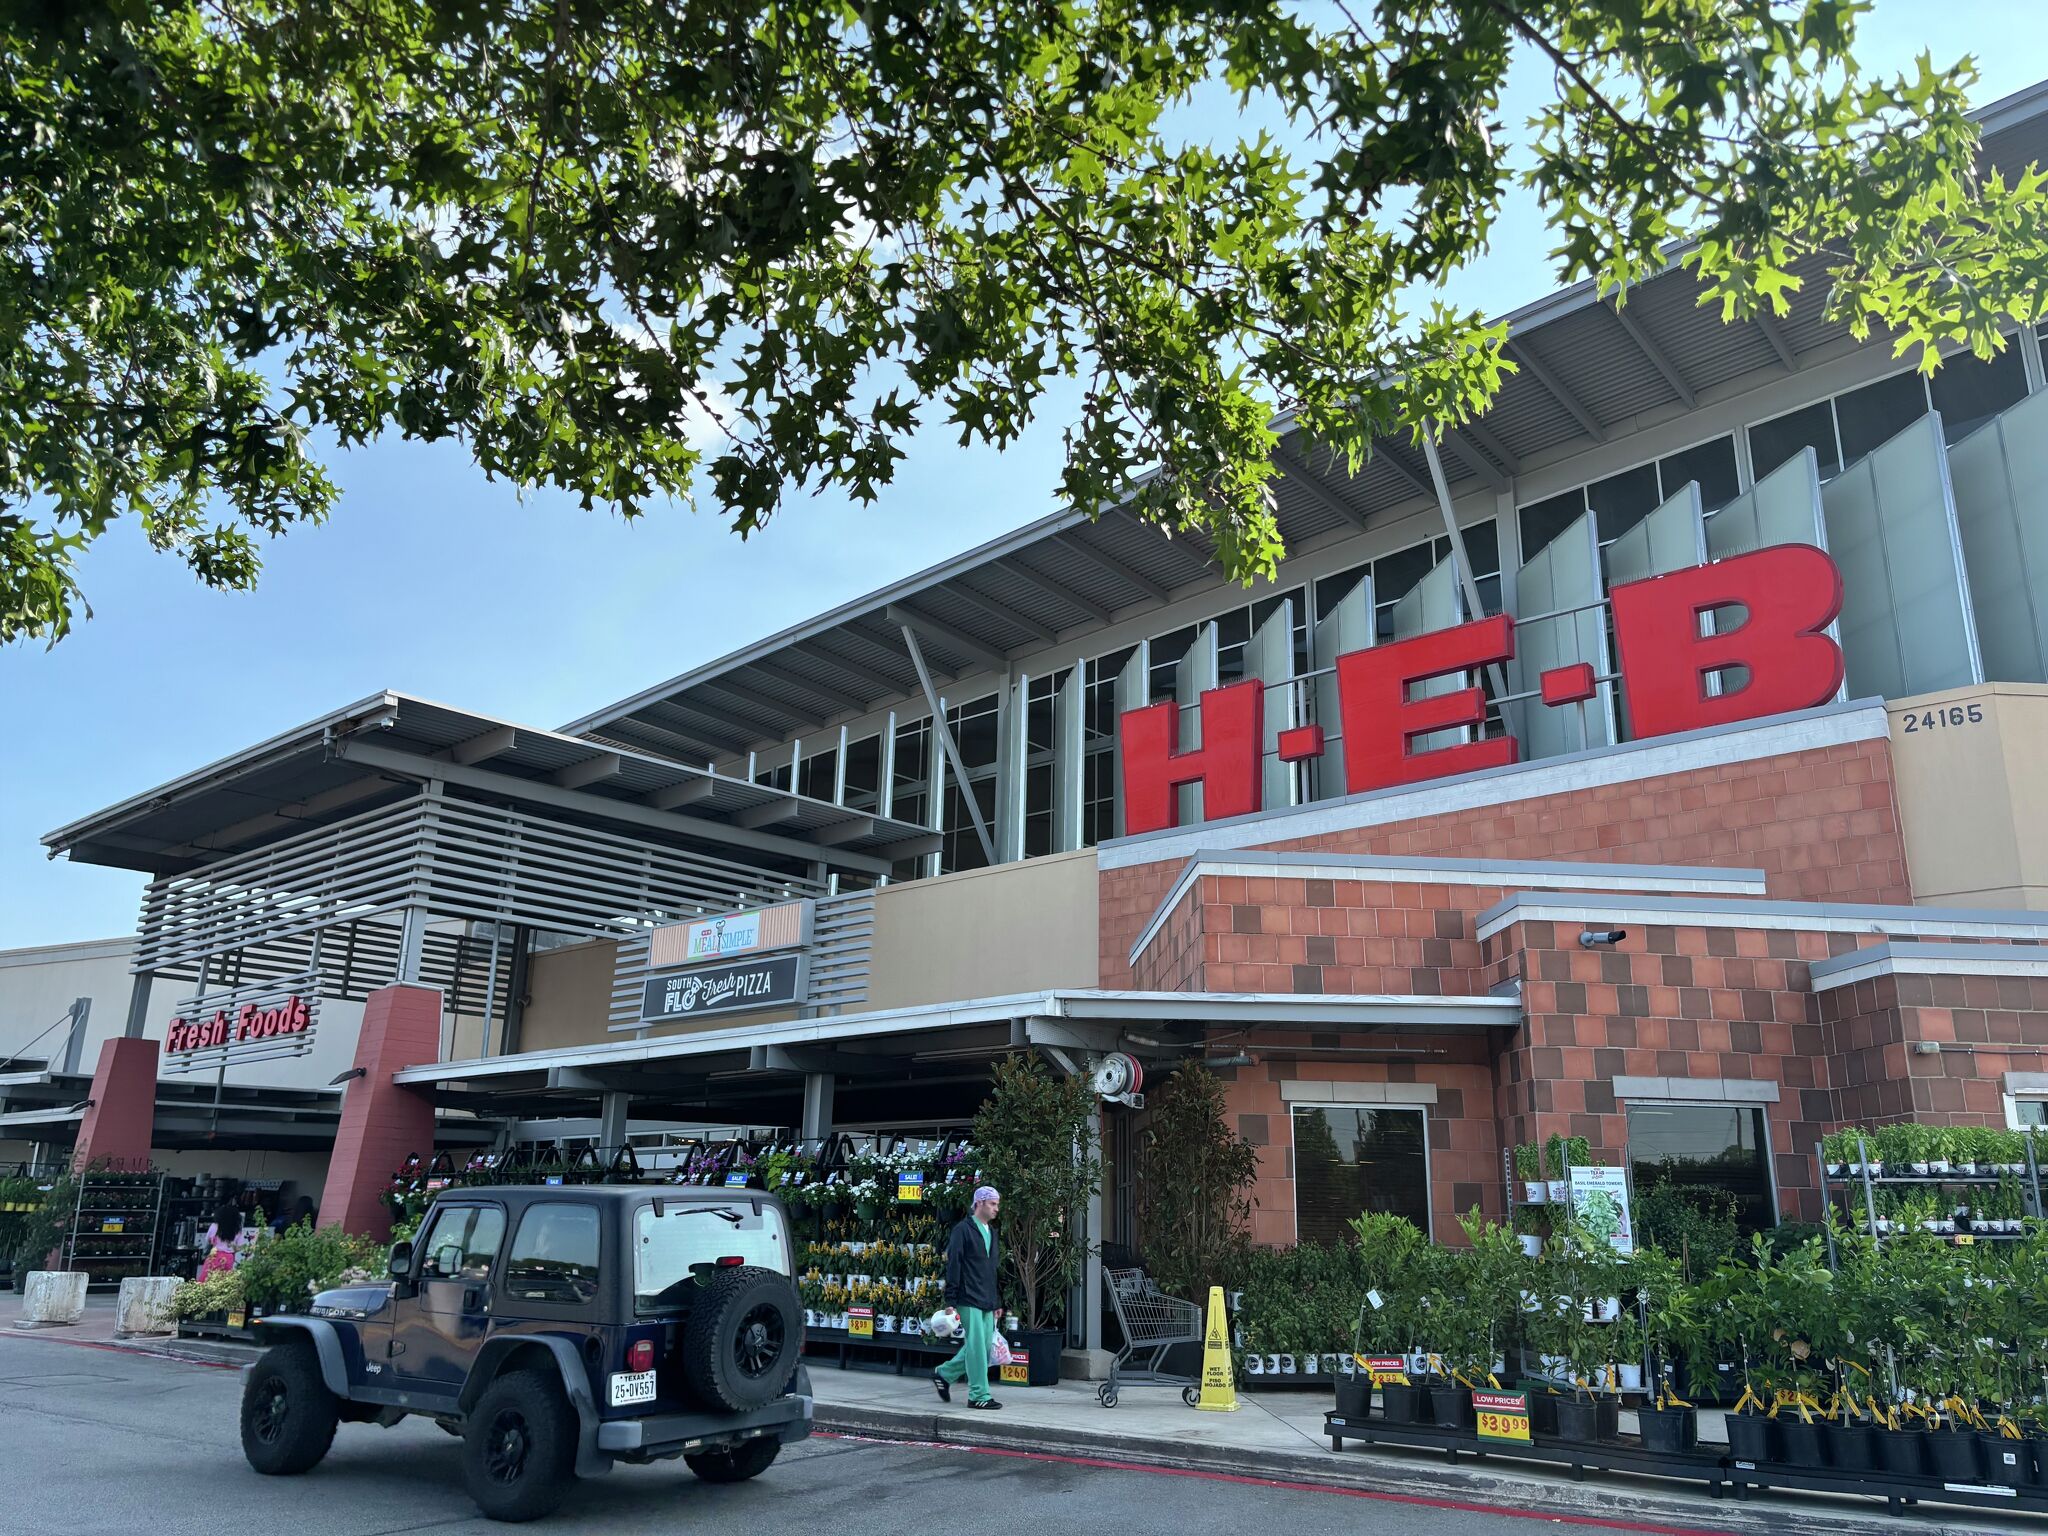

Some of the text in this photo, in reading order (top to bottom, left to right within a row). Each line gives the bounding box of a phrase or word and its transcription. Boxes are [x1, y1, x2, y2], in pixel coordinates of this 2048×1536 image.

[1903, 704, 1983, 733] 24165
[693, 929, 753, 953] MEAL SIMPLE
[664, 971, 771, 1013] FLO Fresh PIZZA
[667, 977, 693, 991] SOUTH
[165, 995, 311, 1053] Fresh Foods
[366, 1362, 382, 1375] Jeep
[624, 1374, 645, 1382] TEXAS
[1476, 1395, 1520, 1405] LOW PRICES
